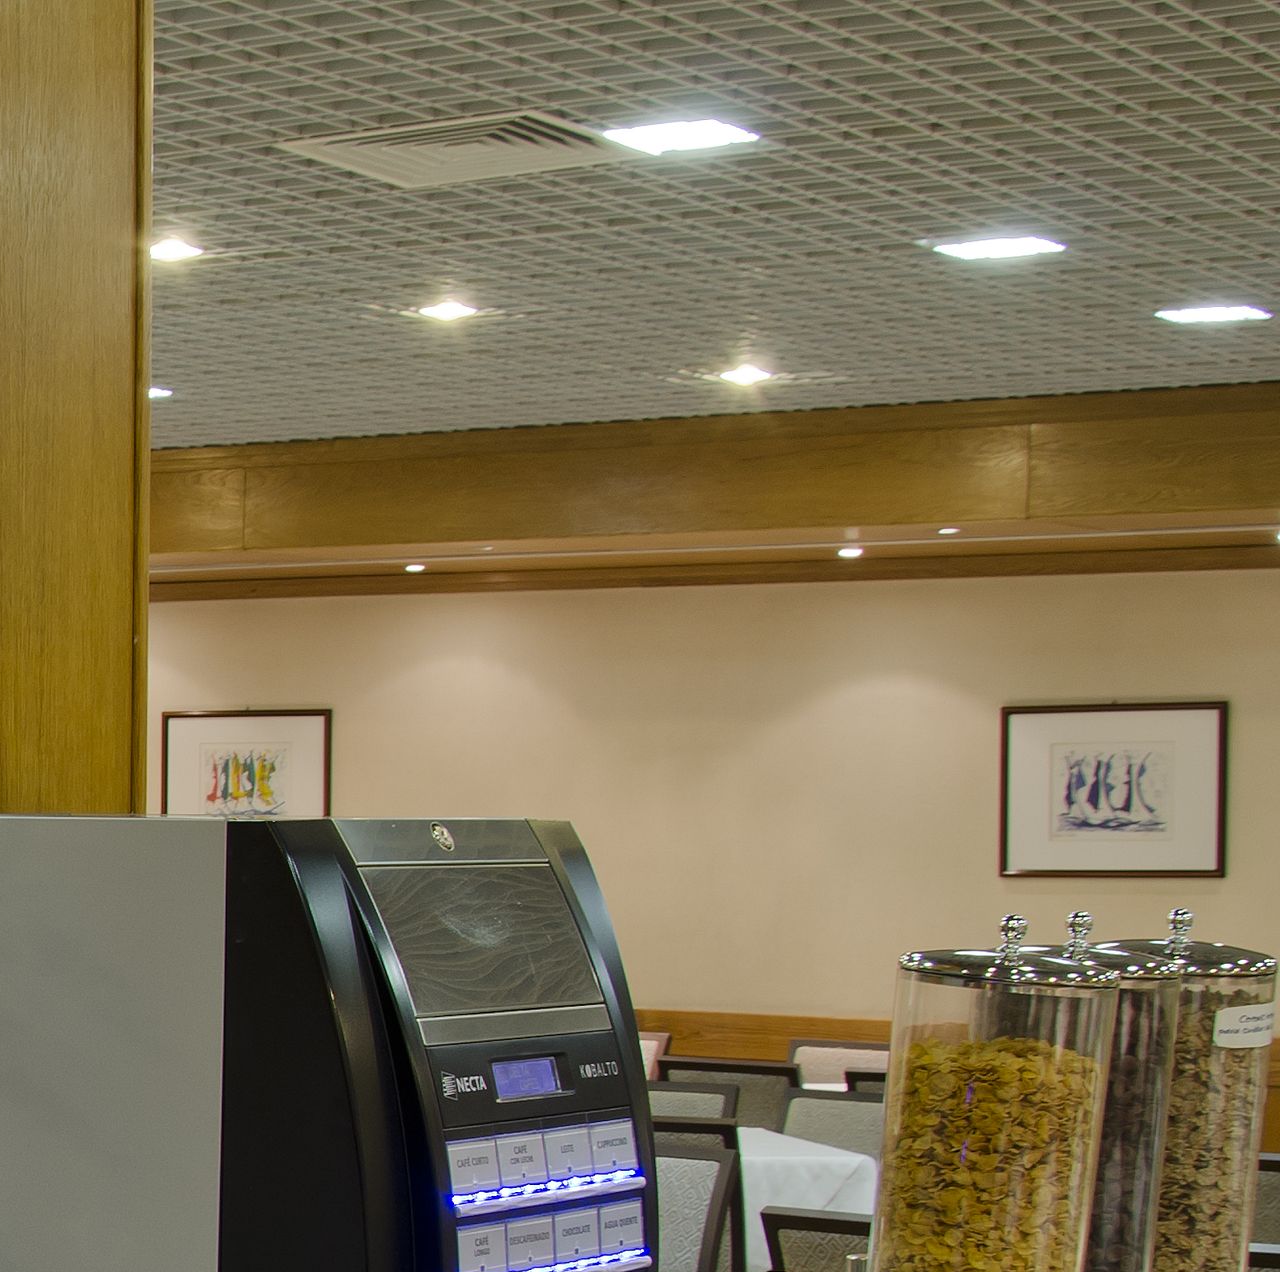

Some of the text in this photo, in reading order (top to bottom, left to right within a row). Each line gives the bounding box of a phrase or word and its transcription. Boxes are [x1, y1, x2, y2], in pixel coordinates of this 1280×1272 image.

[579, 1060, 619, 1079] KOBALTO
[455, 1075, 487, 1093] NECTA
[562, 1224, 591, 1238] CHOCOLATE
